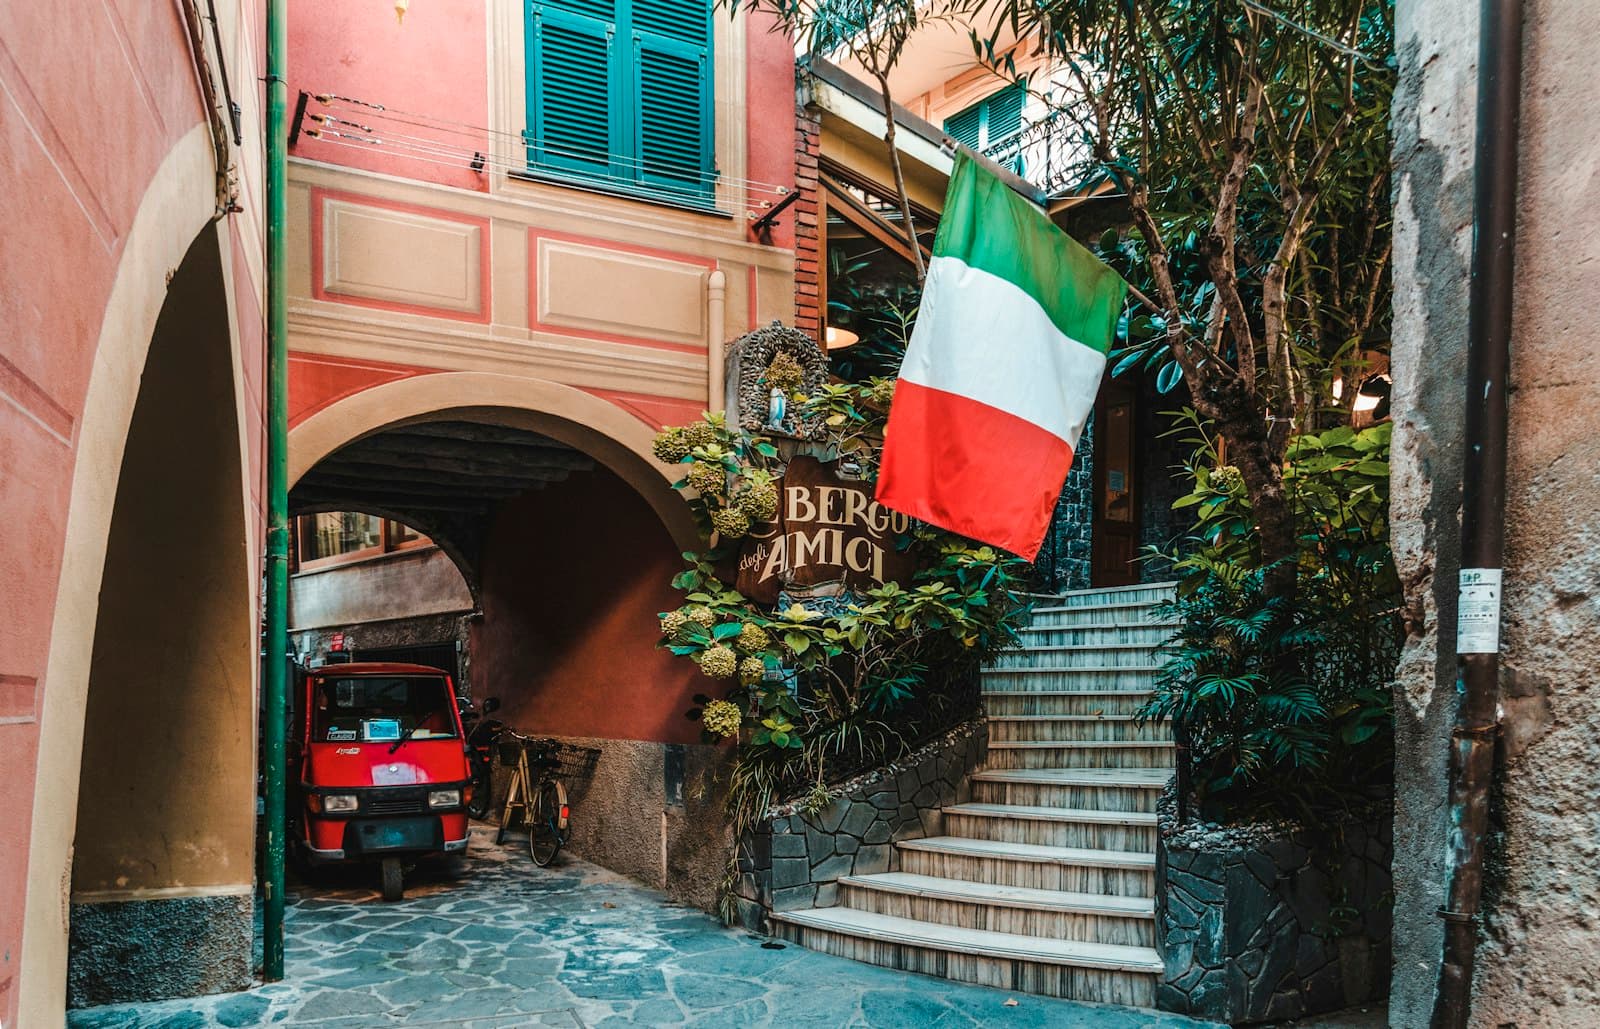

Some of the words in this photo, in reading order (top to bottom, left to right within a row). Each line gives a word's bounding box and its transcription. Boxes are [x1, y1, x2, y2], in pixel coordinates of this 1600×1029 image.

[747, 486, 909, 539] BERGO
[739, 543, 770, 572] degli
[757, 528, 886, 585] AMICI
